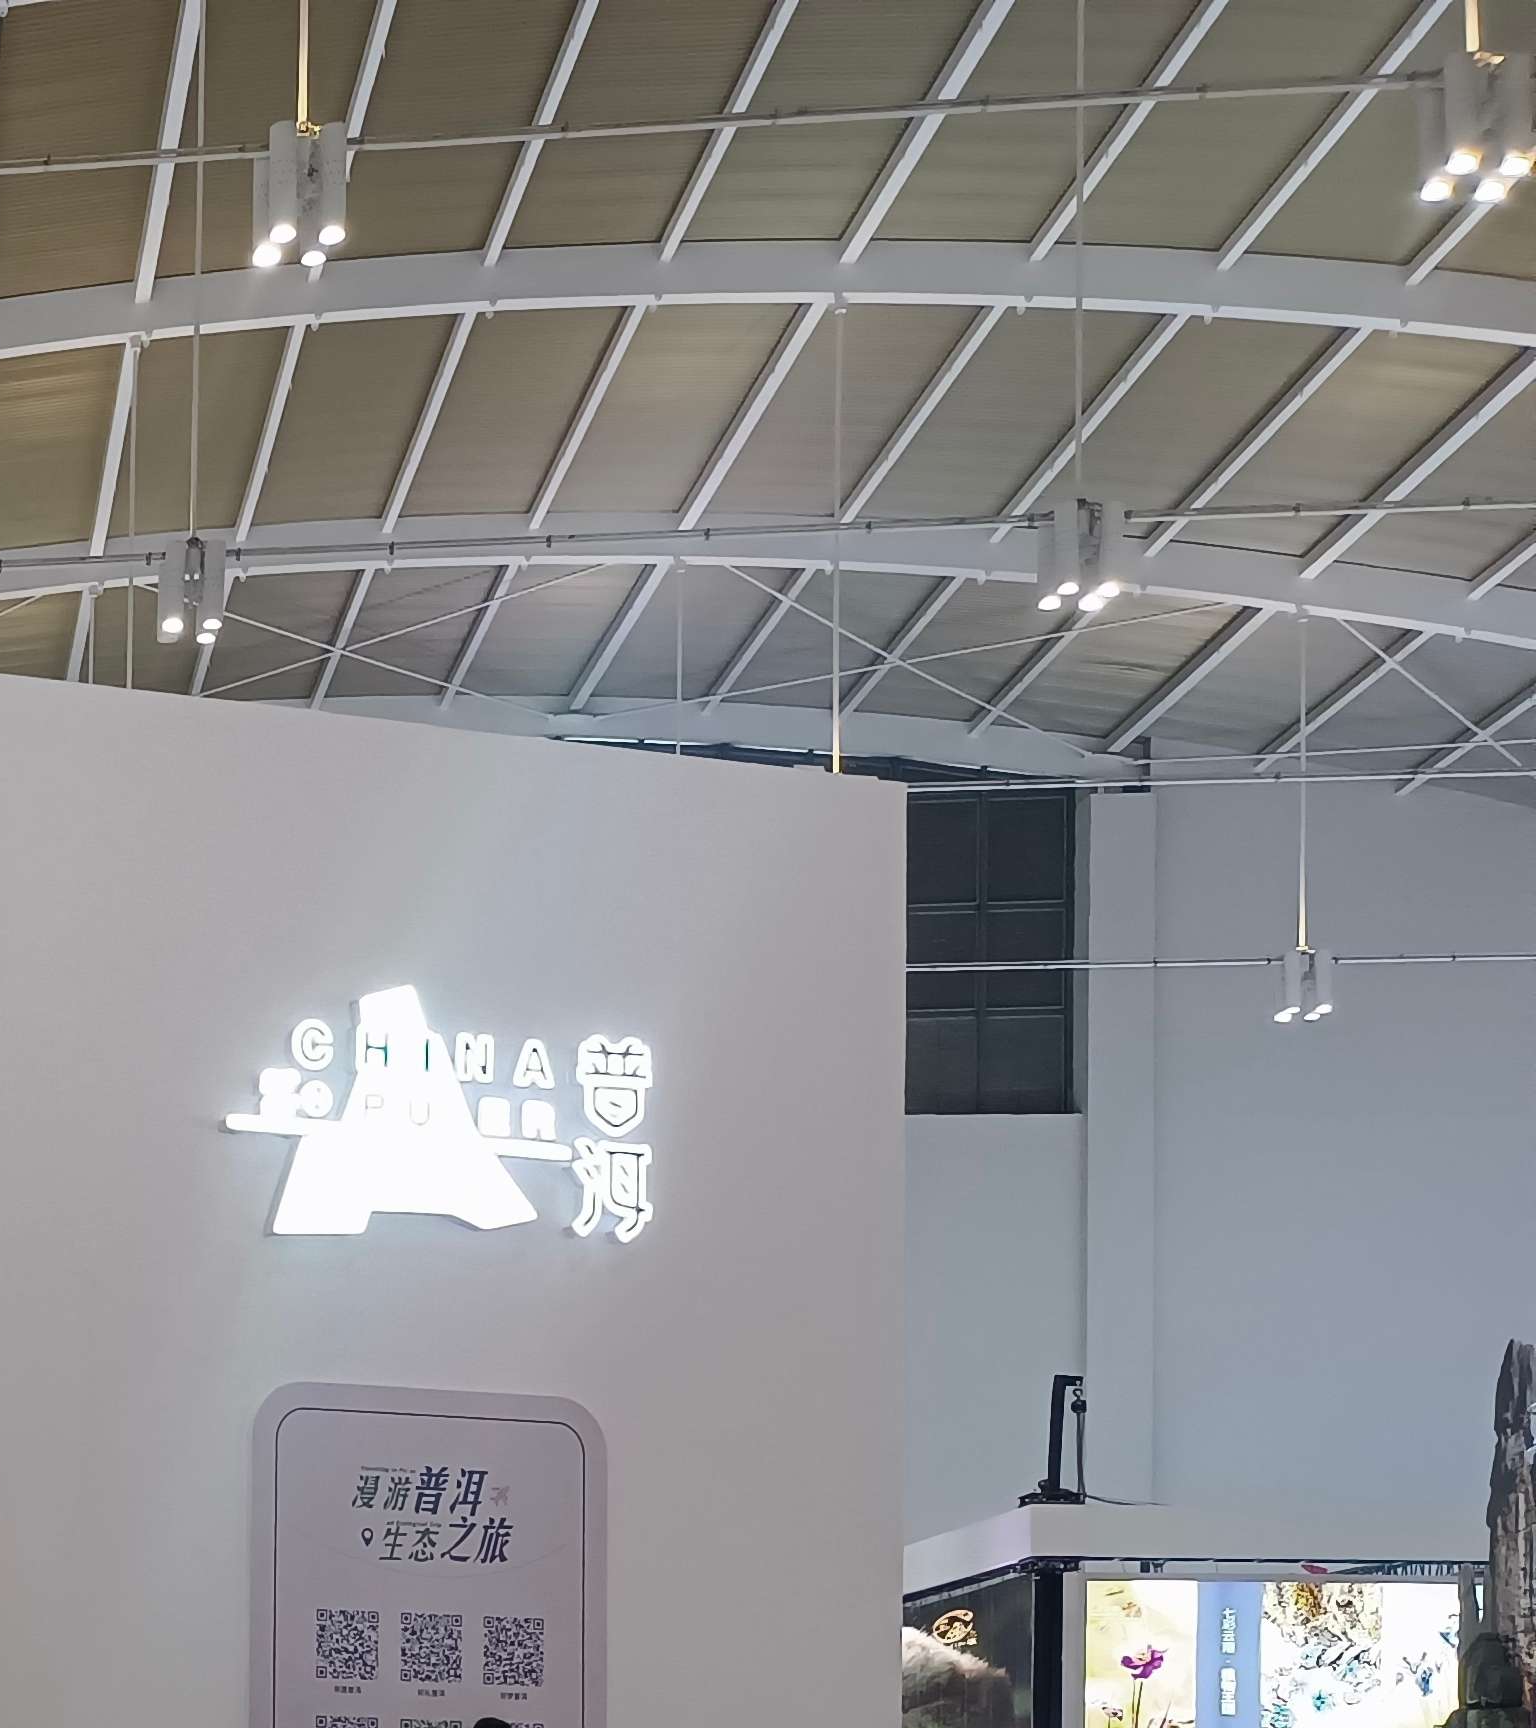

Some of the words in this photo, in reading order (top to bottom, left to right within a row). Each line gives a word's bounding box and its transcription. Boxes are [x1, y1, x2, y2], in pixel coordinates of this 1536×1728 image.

[352, 1466, 488, 1517] 漫游普洱
[379, 1516, 513, 1564] 生态之旅
